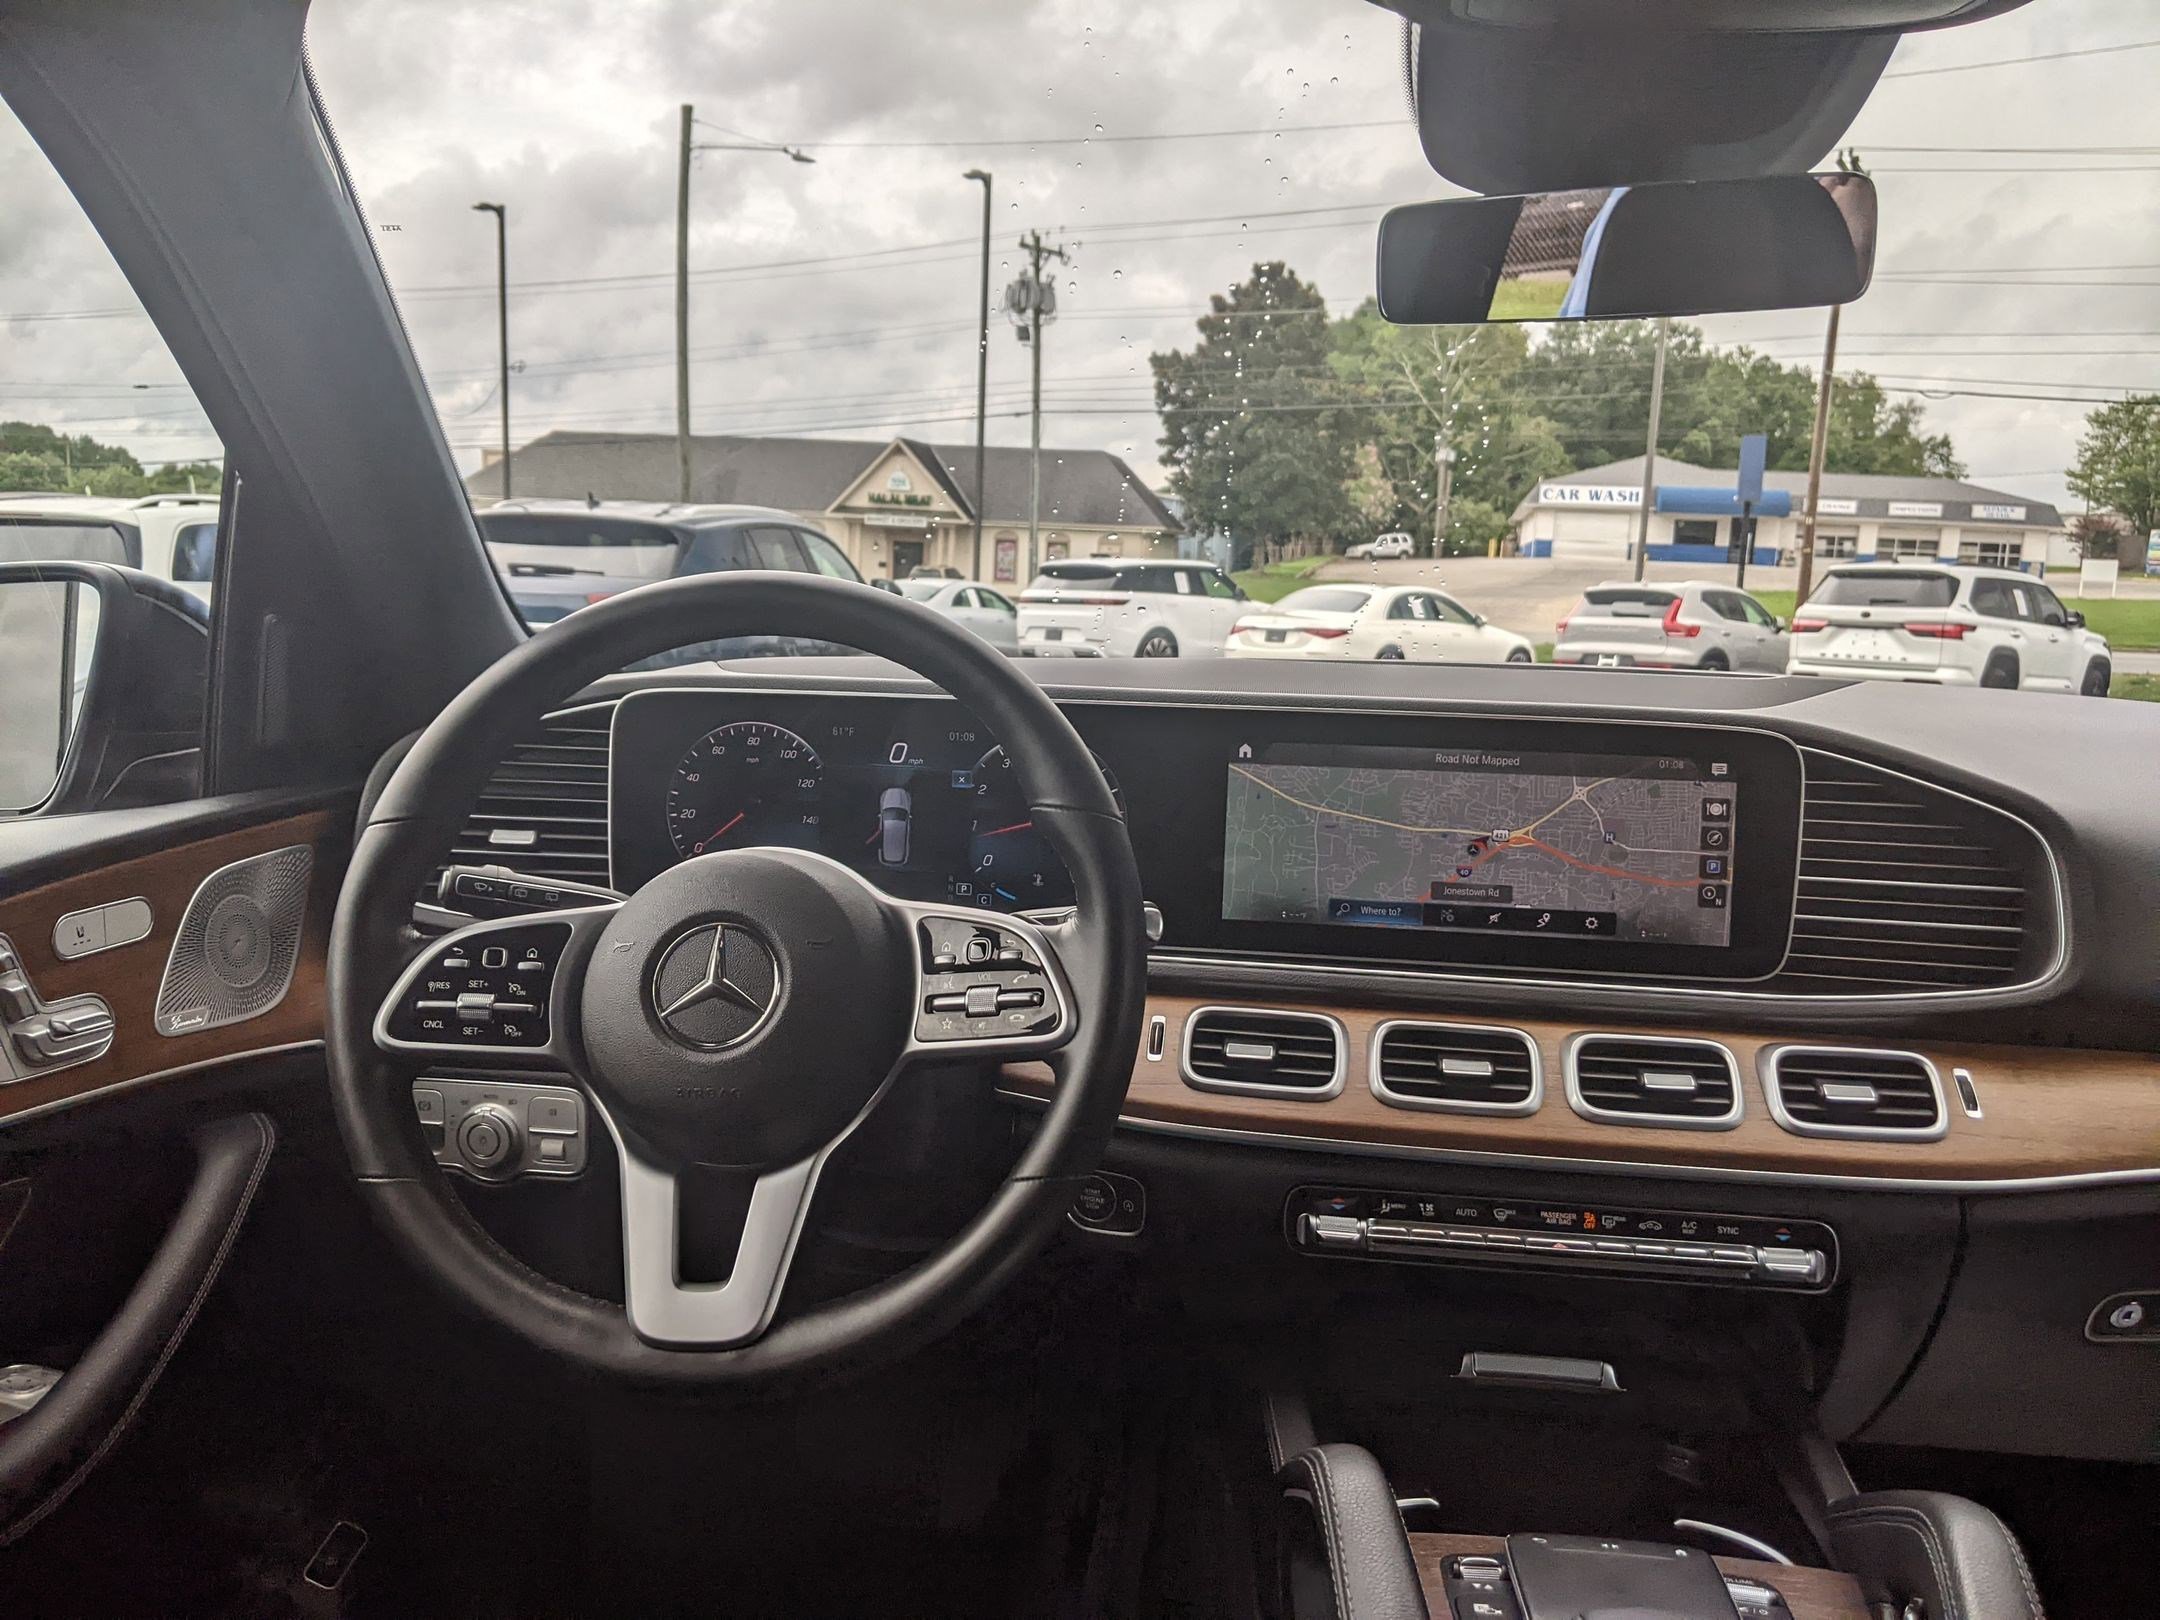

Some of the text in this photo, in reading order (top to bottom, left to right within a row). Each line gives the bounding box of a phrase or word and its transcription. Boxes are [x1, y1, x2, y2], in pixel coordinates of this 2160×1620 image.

[1542, 487, 1641, 503] CAR WASH
[747, 737, 760, 746] 80
[949, 732, 976, 742] 01:08
[712, 746, 725, 755] 60
[780, 750, 797, 759] 100
[888, 742, 924, 766] 0 mph
[1002, 758, 1011, 769] 3
[1435, 753, 1520, 767] Road Not Mapped
[1658, 759, 1685, 769] 01:08
[686, 773, 700, 782] 40
[798, 779, 815, 788] 120
[977, 784, 987, 795] 2
[680, 809, 696, 819] 20
[694, 842, 704, 854] 0
[982, 854, 993, 866] 0
[1443, 886, 1500, 897] Jonestown Rd
[1360, 905, 1401, 917] Where to?
[423, 1020, 444, 1029] CNCL
[1455, 1208, 1477, 1217] AUTO
[1540, 1211, 1577, 1220] PASSENGER
[1681, 1220, 1697, 1230] A/C
[1717, 1225, 1740, 1235] SYNC
